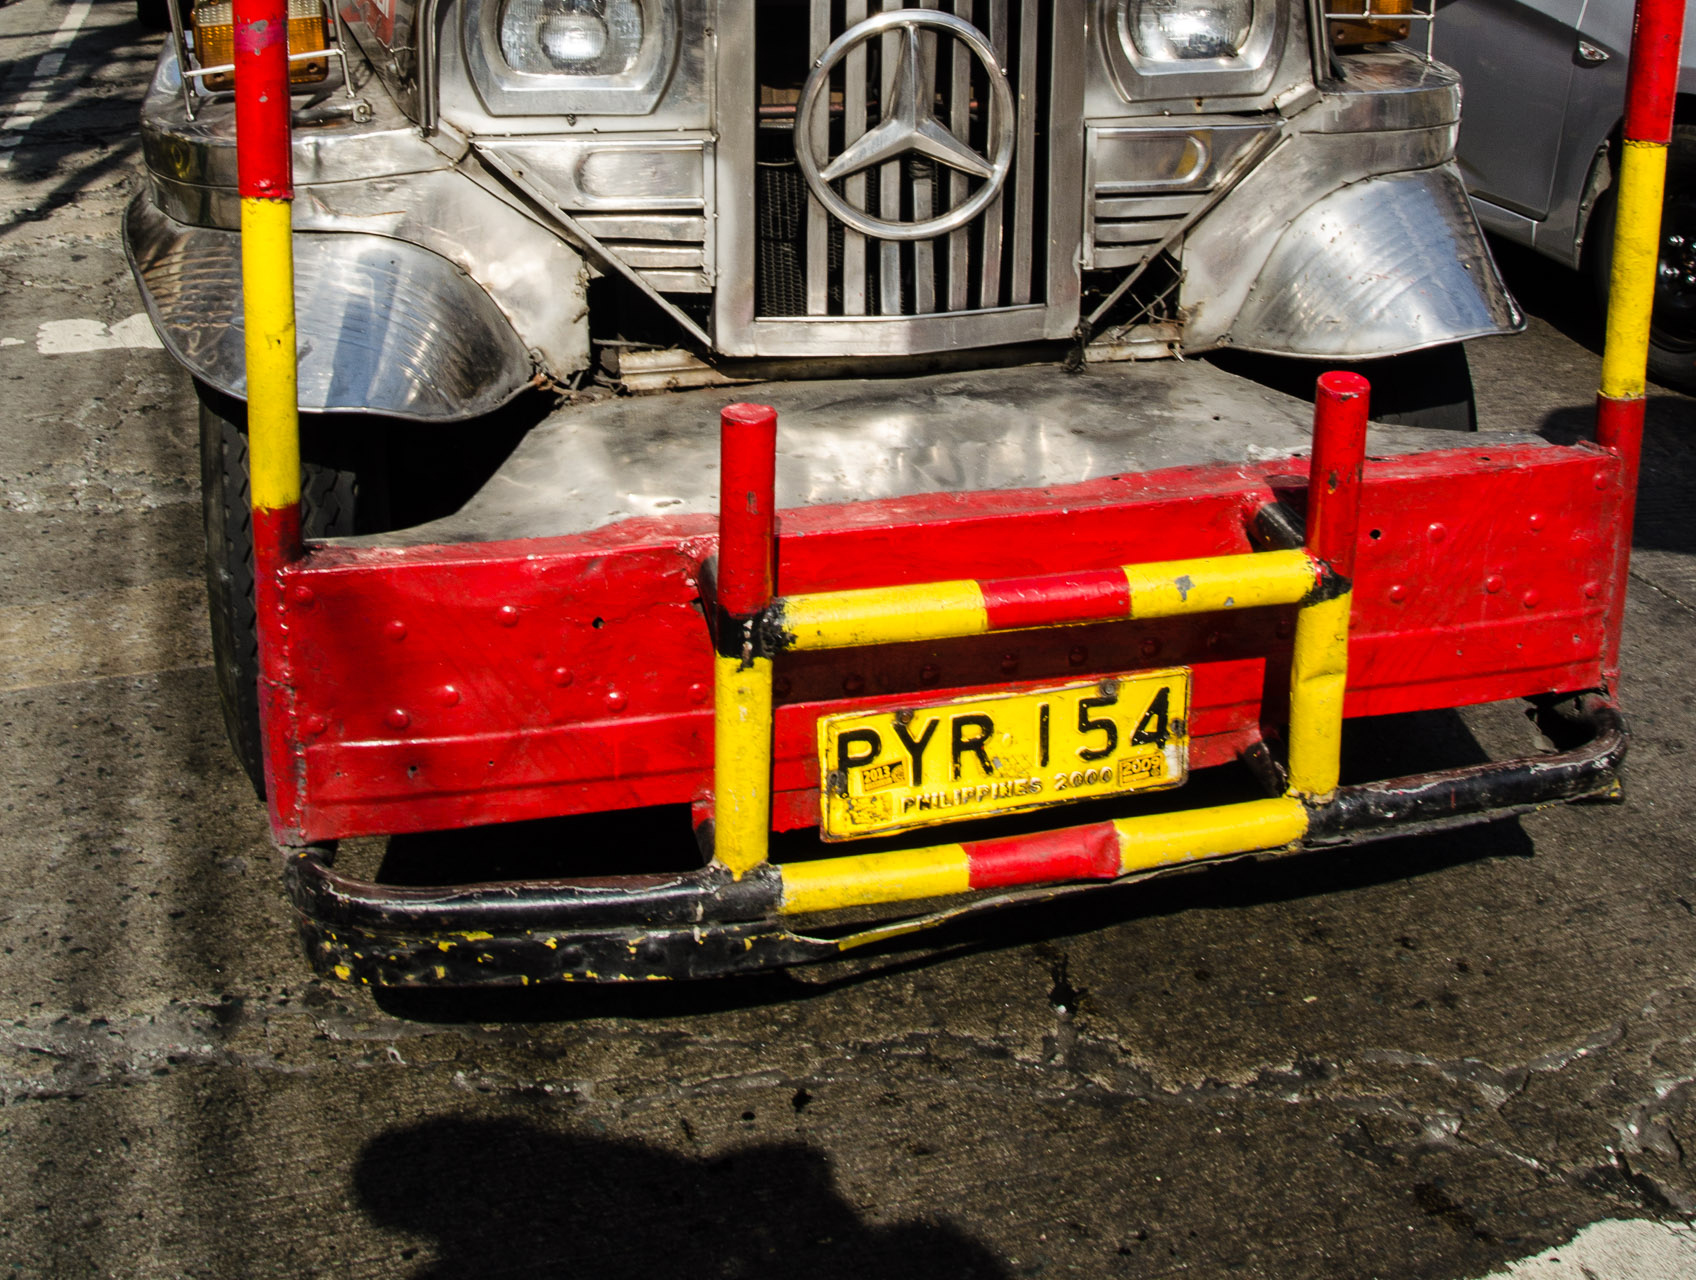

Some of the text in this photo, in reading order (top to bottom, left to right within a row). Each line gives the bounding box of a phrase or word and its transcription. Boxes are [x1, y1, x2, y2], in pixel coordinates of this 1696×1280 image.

[837, 686, 1171, 798] PYR 154
[863, 765, 891, 784] 2013
[1121, 756, 1161, 776] 2009
[900, 766, 1113, 813] PHILIPPINES 2000
